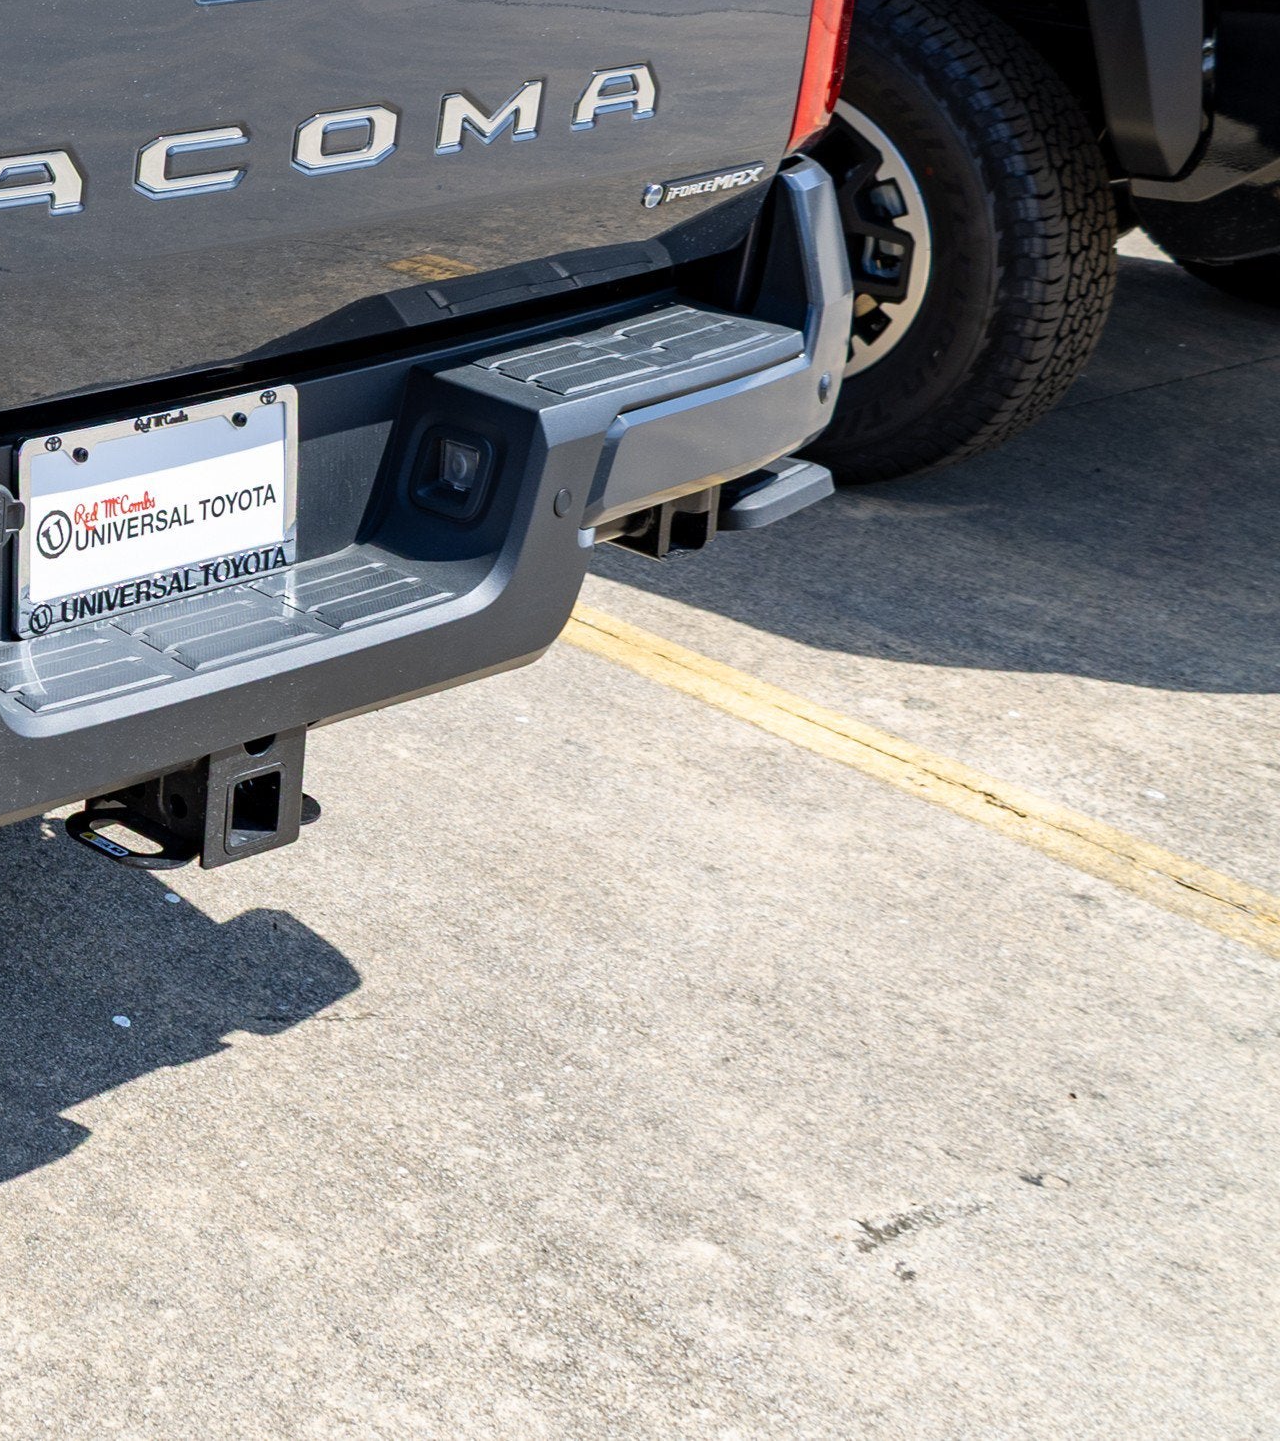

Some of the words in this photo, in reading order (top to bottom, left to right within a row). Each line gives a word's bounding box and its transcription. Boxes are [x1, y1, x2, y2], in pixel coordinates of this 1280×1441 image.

[74, 502, 99, 531] Red
[101, 491, 156, 518] McCombs
[75, 504, 194, 551] UNIVERSAL
[198, 484, 277, 518] TOYOTA
[60, 568, 197, 623] UNIVERSAL
[197, 544, 288, 588] TOYOTA
